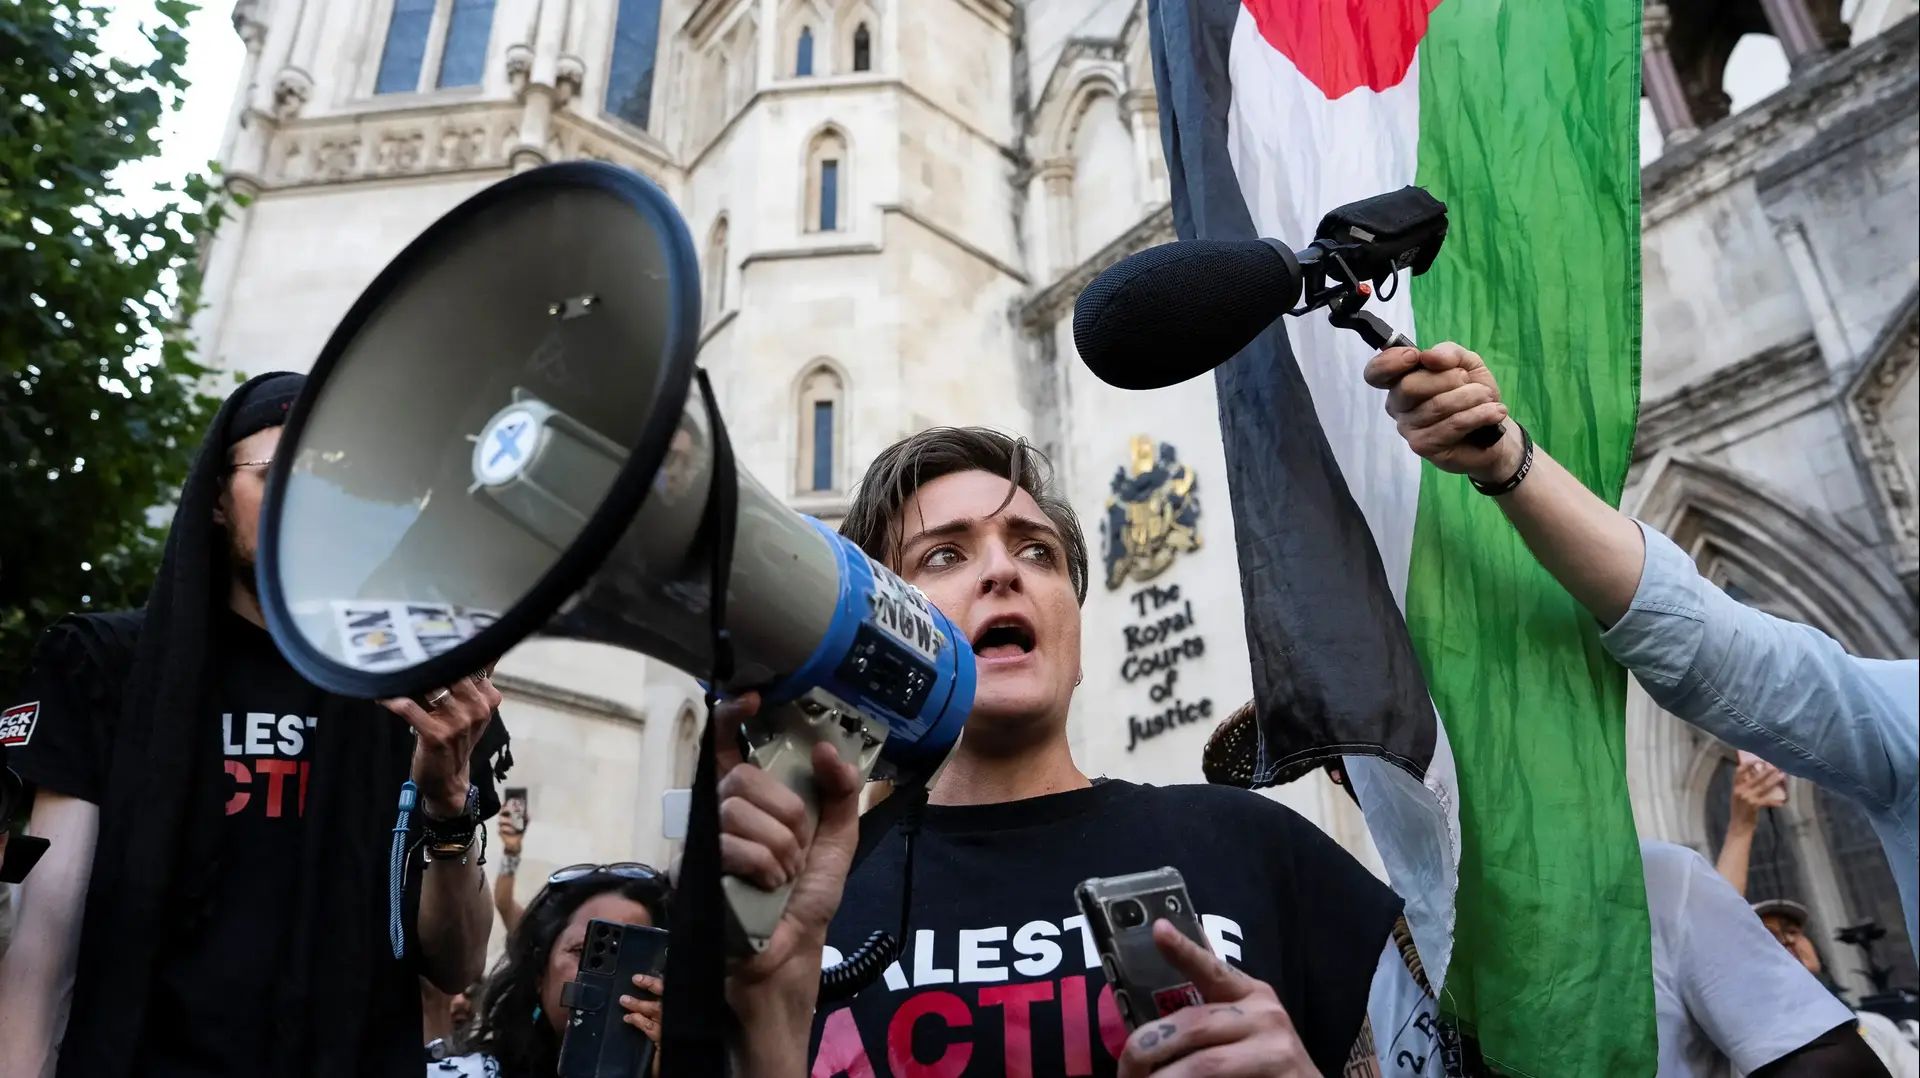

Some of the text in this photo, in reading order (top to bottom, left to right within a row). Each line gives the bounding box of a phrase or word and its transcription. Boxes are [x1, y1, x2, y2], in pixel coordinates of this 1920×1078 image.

[1131, 584, 1180, 617] The
[1123, 599, 1194, 652] Royal
[1121, 636, 1205, 683] Courts
[1150, 669, 1178, 703] of
[0, 724, 27, 740] SRL
[1127, 698, 1213, 752] Justice
